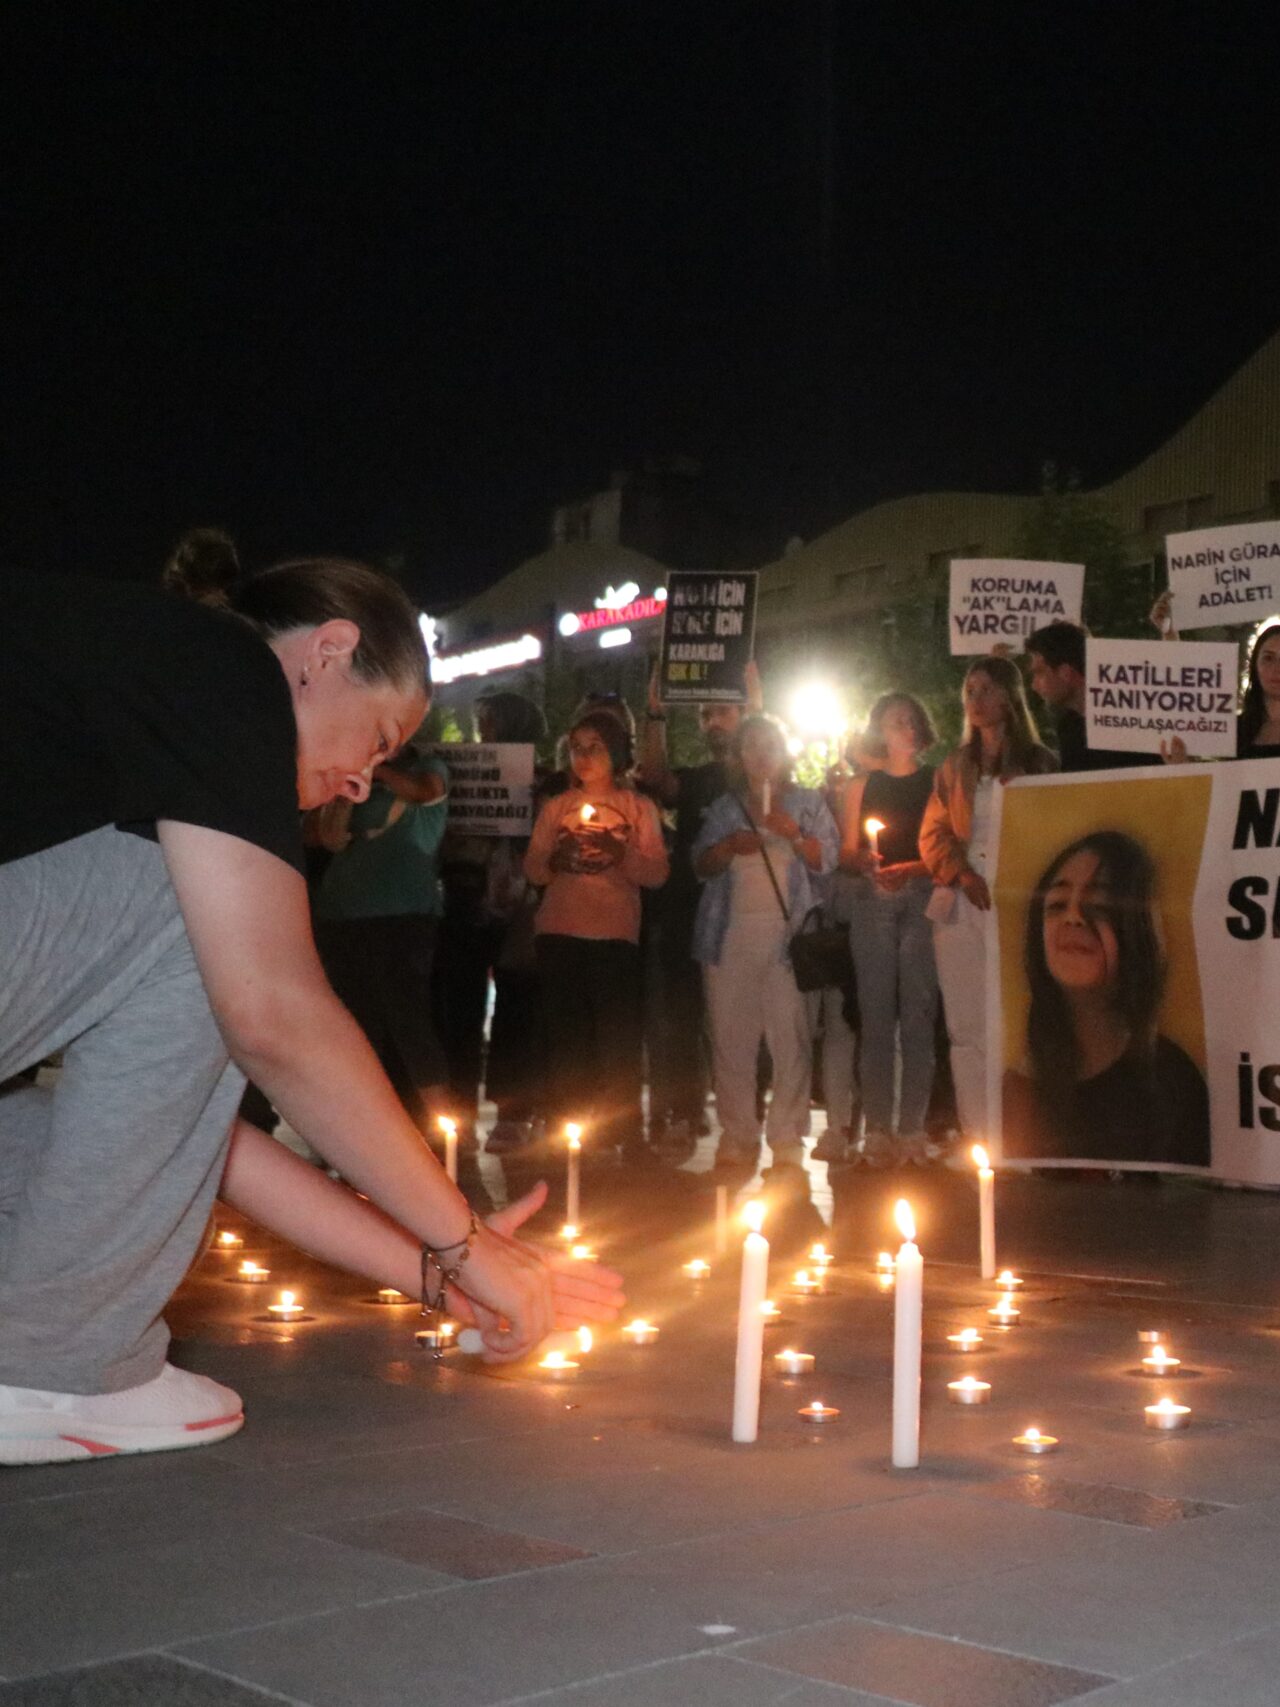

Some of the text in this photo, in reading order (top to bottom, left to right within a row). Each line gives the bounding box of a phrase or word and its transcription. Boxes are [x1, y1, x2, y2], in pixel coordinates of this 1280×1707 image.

[1171, 547, 1225, 571] NARİN
[970, 577, 1058, 597] KORUMA
[1214, 565, 1251, 588] İÇİN
[1198, 585, 1273, 609] ADALET!
[1098, 660, 1223, 689] KATİLLERİ
[1089, 687, 1234, 714] TANIYORUZ
[1093, 714, 1228, 735] HESAPLAŞACAĞIZ!
